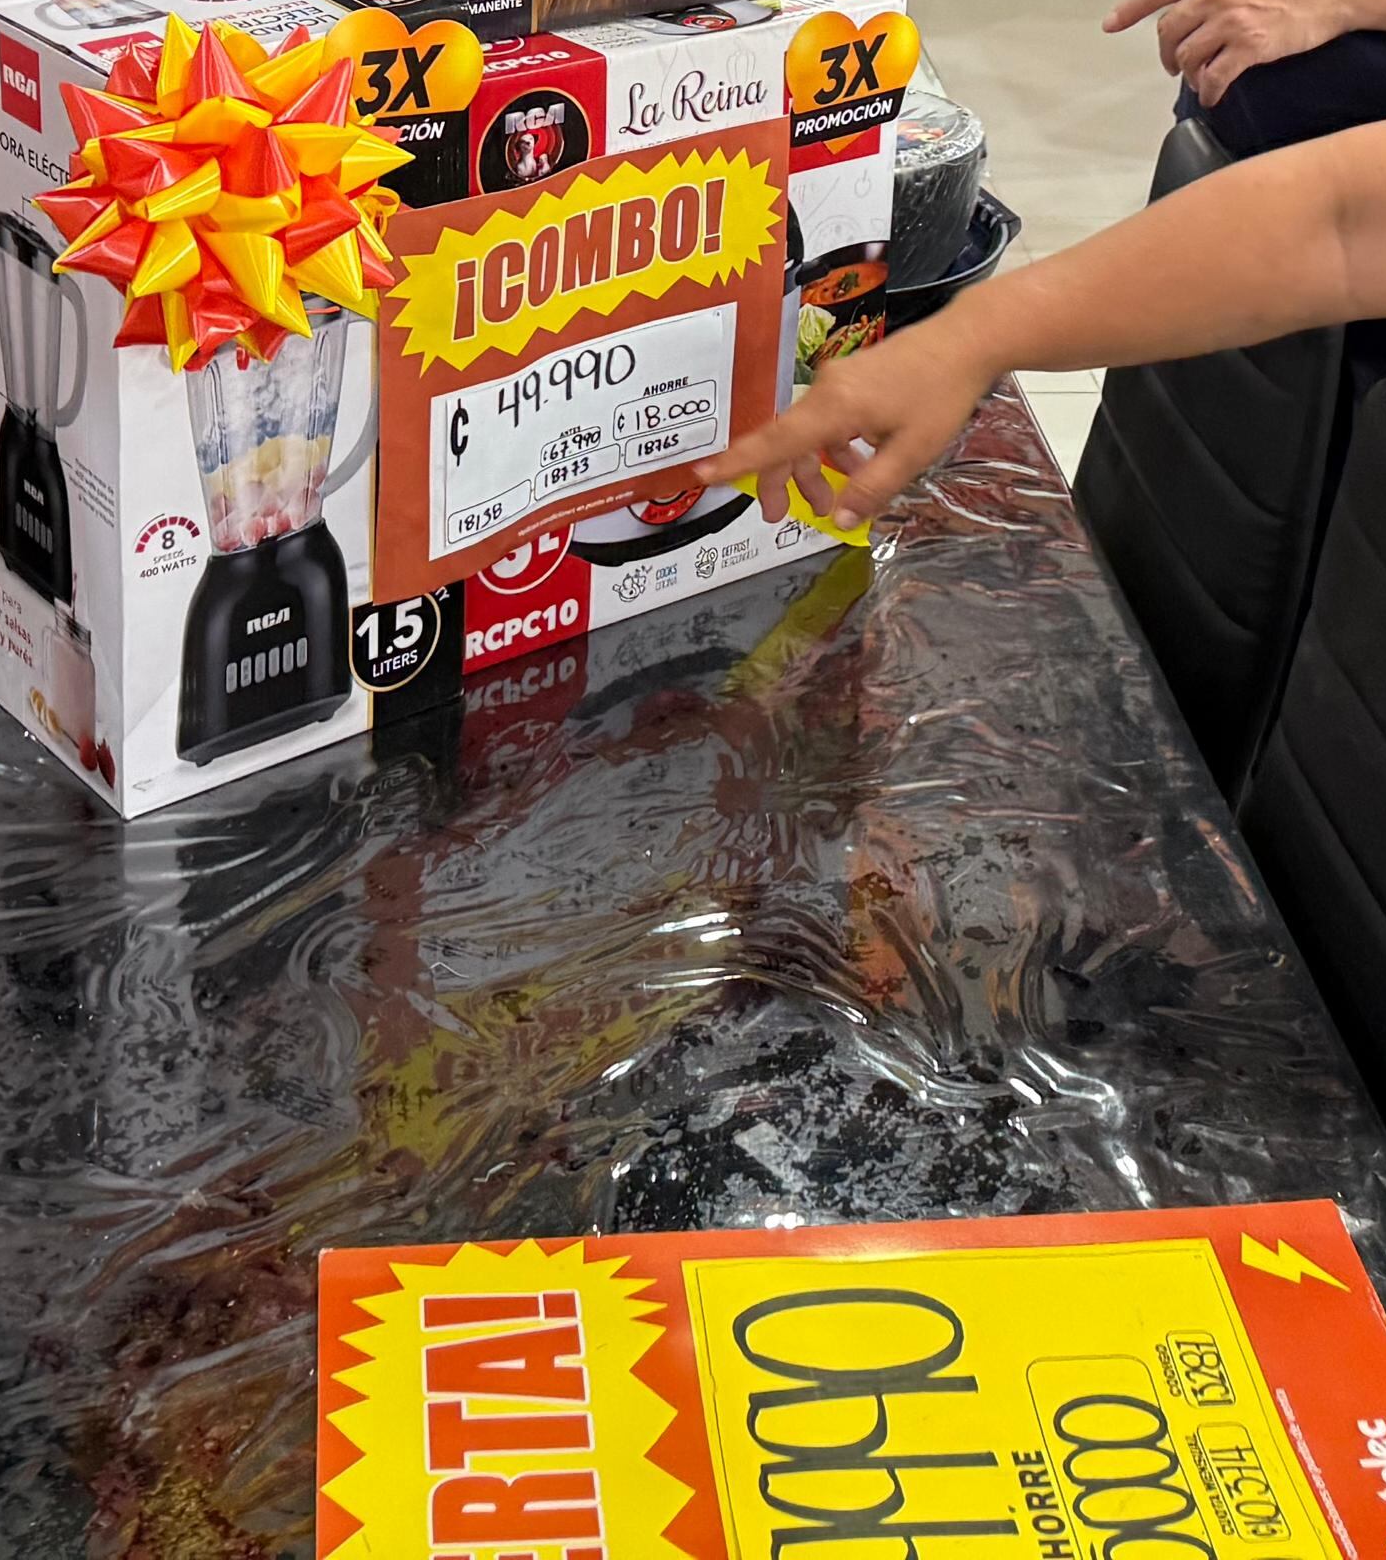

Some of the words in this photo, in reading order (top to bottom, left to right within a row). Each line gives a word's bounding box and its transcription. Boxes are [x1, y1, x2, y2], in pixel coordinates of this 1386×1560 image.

[2, 63, 38, 102] RCA
[355, 42, 446, 119] 3X
[812, 31, 889, 107] 3X
[504, 101, 566, 136] RCA
[618, 82, 665, 136] La
[672, 69, 768, 123] Reina
[793, 96, 894, 140] PROMOCIÓN
[449, 177, 726, 343] ¡COMBO!
[497, 343, 637, 428] 49.990
[642, 376, 690, 397] AHORRE
[634, 398, 711, 432] 18.000
[23, 478, 45, 507] RCA
[161, 530, 176, 551] 8
[139, 565, 160, 580] 400
[161, 554, 198, 575] WATTS
[246, 606, 292, 635] RCA
[355, 596, 424, 662] 1.5
[463, 598, 580, 661] RCPC10
[372, 649, 420, 679] LITERS
[421, 1289, 608, 1560] RTA!
[1010, 1448, 1077, 1560] HORRE
